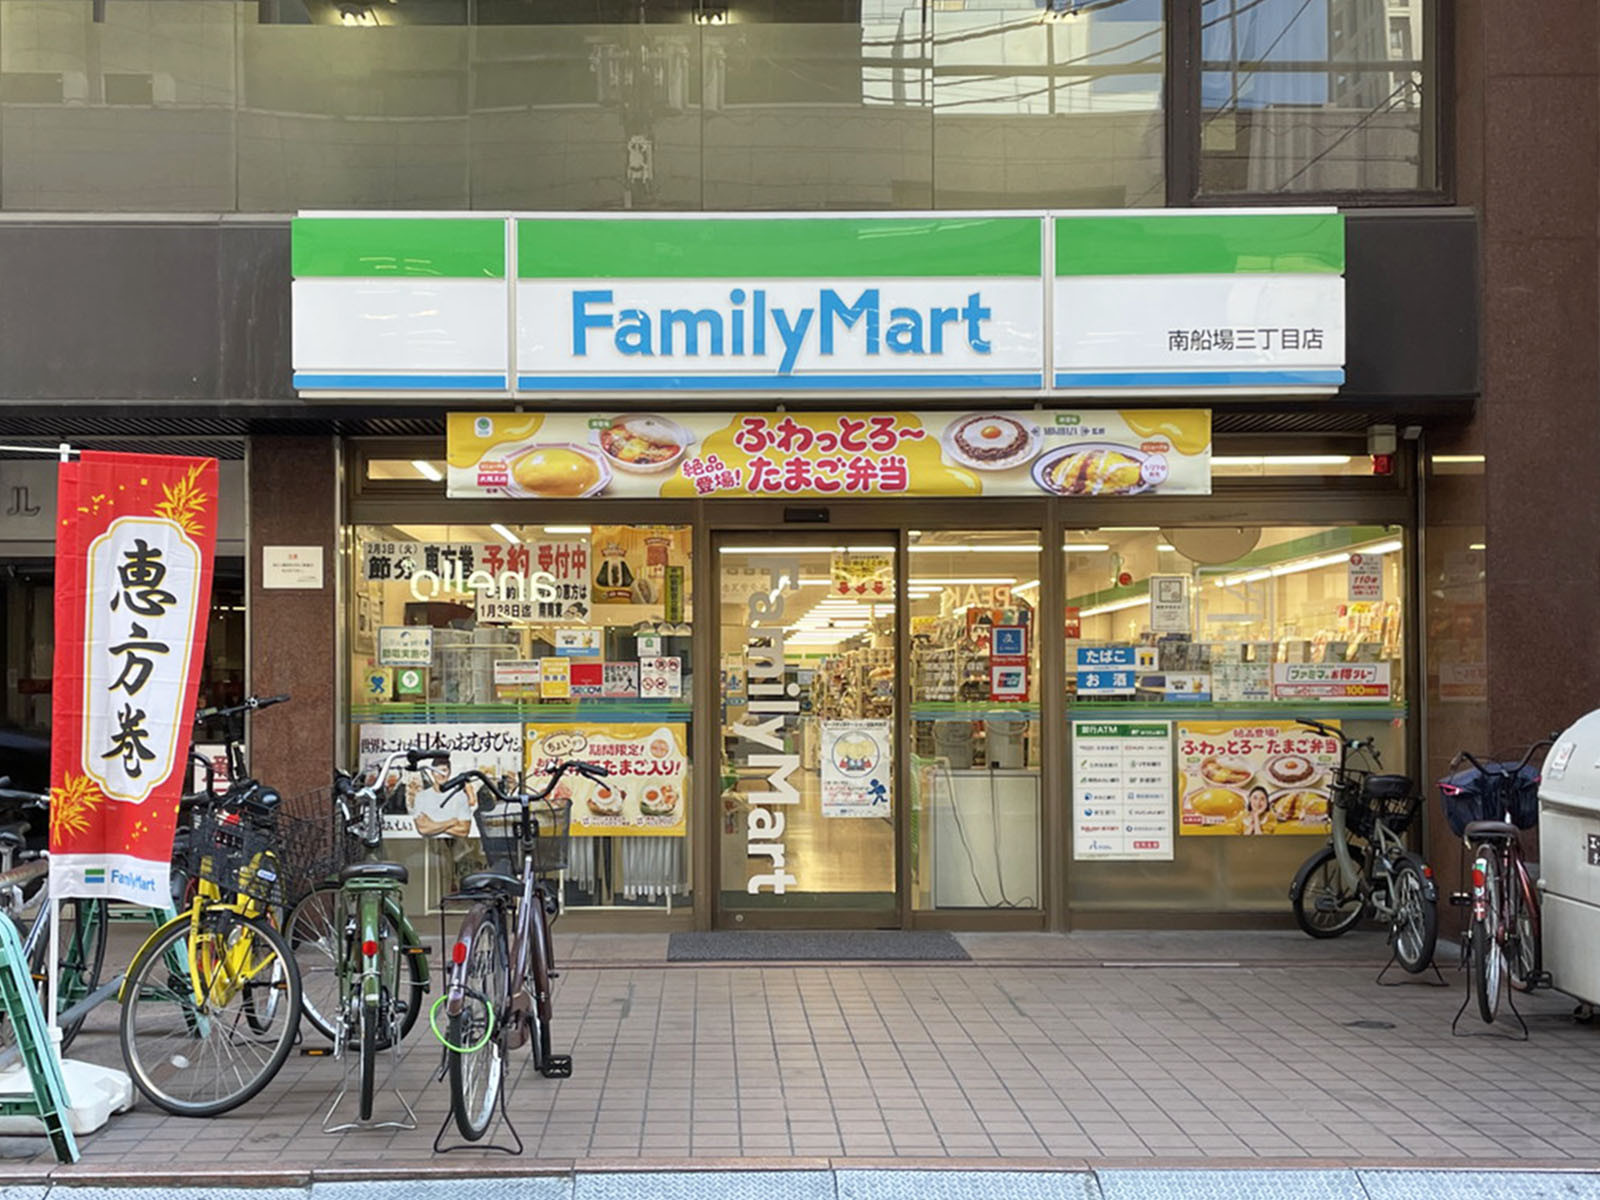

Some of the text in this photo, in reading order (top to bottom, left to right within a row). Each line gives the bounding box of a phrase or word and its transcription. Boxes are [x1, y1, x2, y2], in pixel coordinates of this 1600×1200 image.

[571, 288, 992, 375] FamilyMart
[1167, 327, 1324, 352] 南船場三丁目店
[682, 455, 725, 478] 絶品
[747, 455, 908, 493] たまご弁当
[694, 468, 742, 494] 登場!
[368, 556, 416, 580] 節分
[424, 544, 475, 580] 恵方巻
[482, 544, 530, 580] 予約
[538, 544, 587, 580] 受付中
[480, 603, 532, 619] 1月28日迄
[101, 538, 178, 778] 恵方巻
[1085, 649, 1127, 664] たばこ
[571, 686, 602, 694] SECOM
[1085, 673, 1128, 688] お酒
[733, 558, 800, 895] FamilyMart
[570, 759, 682, 777] たまご入り!
